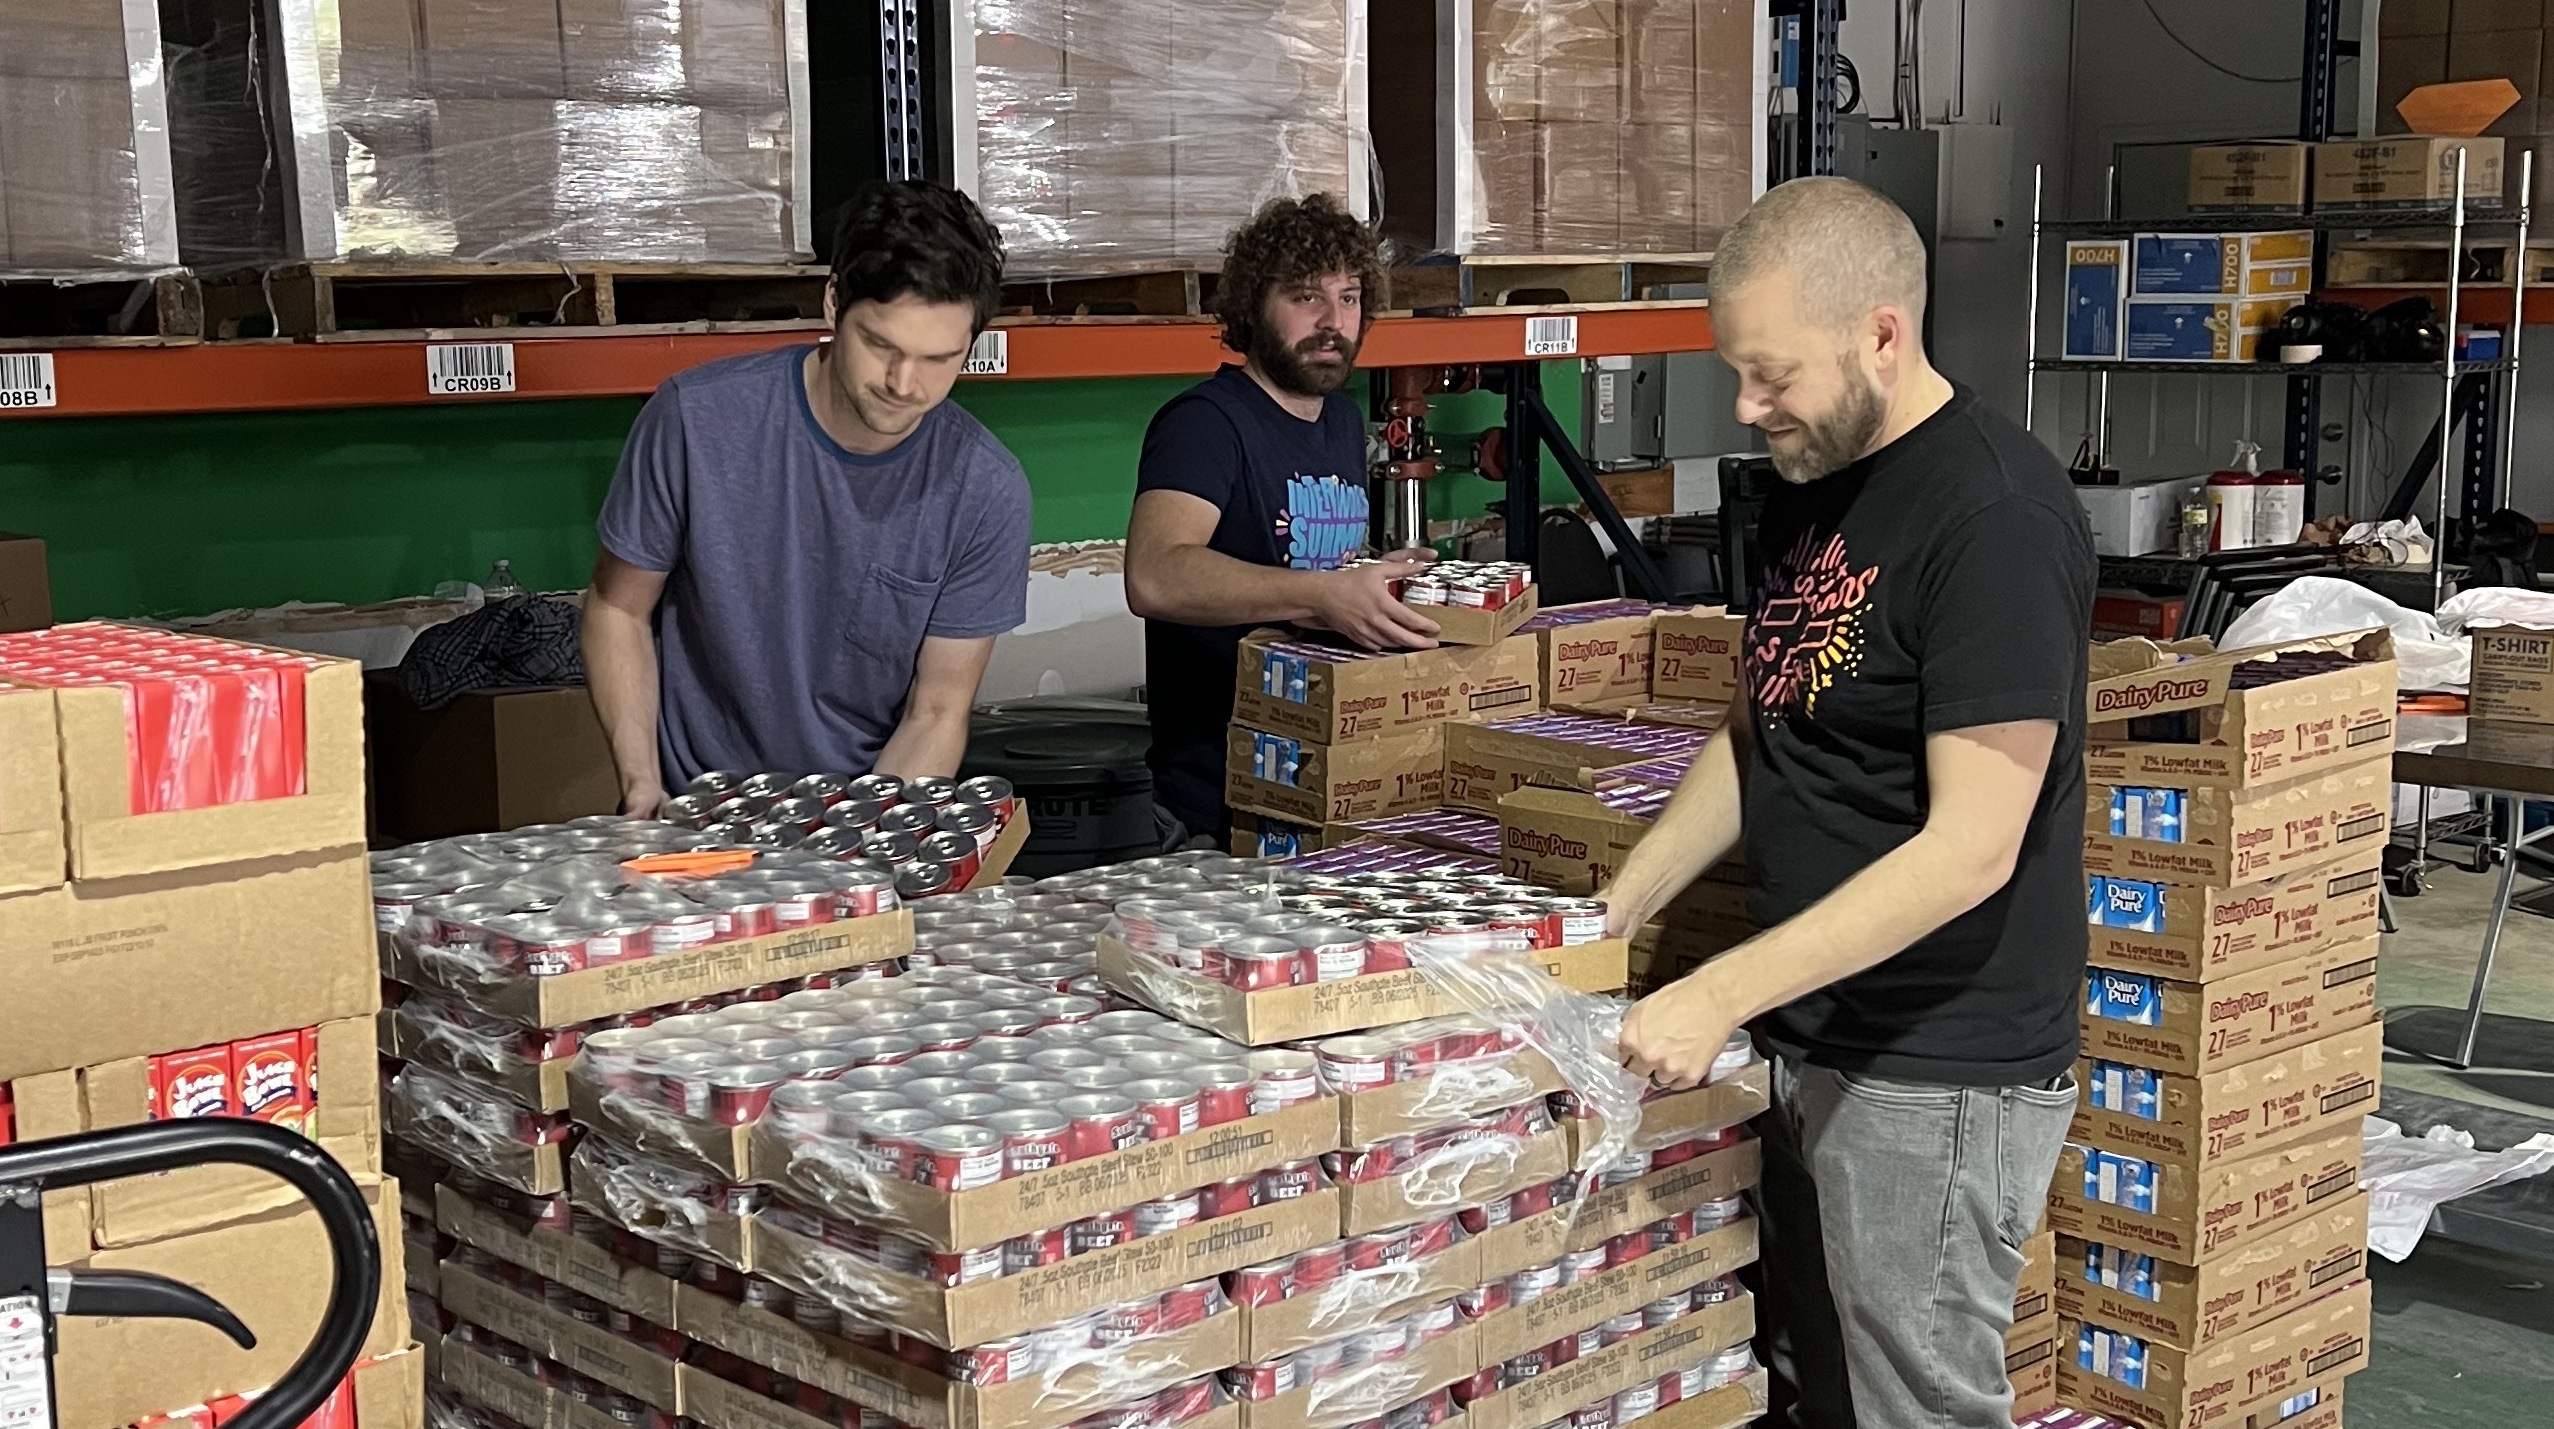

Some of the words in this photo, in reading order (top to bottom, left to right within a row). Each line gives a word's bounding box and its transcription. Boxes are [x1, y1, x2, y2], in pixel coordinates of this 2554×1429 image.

[2075, 249, 2115, 263] H700
[2225, 243, 2239, 288] H700
[445, 377, 502, 392] CR09B
[0, 391, 38, 406] 08B
[1558, 640, 1619, 662] DairyPure
[1662, 633, 1730, 655] DairyPure
[2482, 637, 2551, 655] T-SHIRT
[1618, 653, 1635, 677] 1%
[1661, 657, 1681, 677] 27
[1558, 667, 1576, 688] 27
[2096, 679, 2209, 713] DairyPure
[1340, 716, 1357, 735] 27
[2144, 755, 2160, 767] 1%
[2162, 756, 2200, 770] Lowfat
[2203, 760, 2226, 770] Milk
[2250, 752, 2263, 772] 27
[1451, 777, 1468, 797] 27
[1334, 799, 1351, 818] 27
[1508, 826, 1588, 860] DairyPure
[1510, 858, 1531, 881] 27
[2131, 850, 2147, 861] 1%
[2149, 852, 2187, 866] Lowfat
[2189, 857, 2214, 869] Milk
[2238, 852, 2250, 873] 27
[1589, 861, 1612, 893] 1%
[2107, 885, 2147, 903] Dairy
[2110, 896, 2143, 913] Pure
[2109, 940, 2125, 952] 1%
[2126, 942, 2164, 958] Lowfat
[2165, 949, 2188, 962] Milk
[2211, 933, 2231, 958] 27
[2105, 976, 2144, 995] Dairy
[2108, 988, 2140, 1006] Pure
[2106, 1030, 2121, 1042] 1%
[2123, 1032, 2159, 1049] Lowfat
[2160, 1039, 2182, 1052] Milk
[2208, 1028, 2228, 1053] 27
[2124, 1124, 2161, 1142] Lowfat
[2163, 1134, 2185, 1148] Milk
[2208, 1133, 2222, 1156] 27
[2100, 1215, 2114, 1228] 1%
[2116, 1217, 2153, 1235] Lowfat
[2155, 1227, 2178, 1242] Milk
[2204, 1227, 2218, 1250] 27
[2117, 1302, 2155, 1322] Lowfat
[2156, 1314, 2178, 1331] Milk
[2204, 1315, 2218, 1339] 27
[2189, 1405, 2205, 1428] 27
